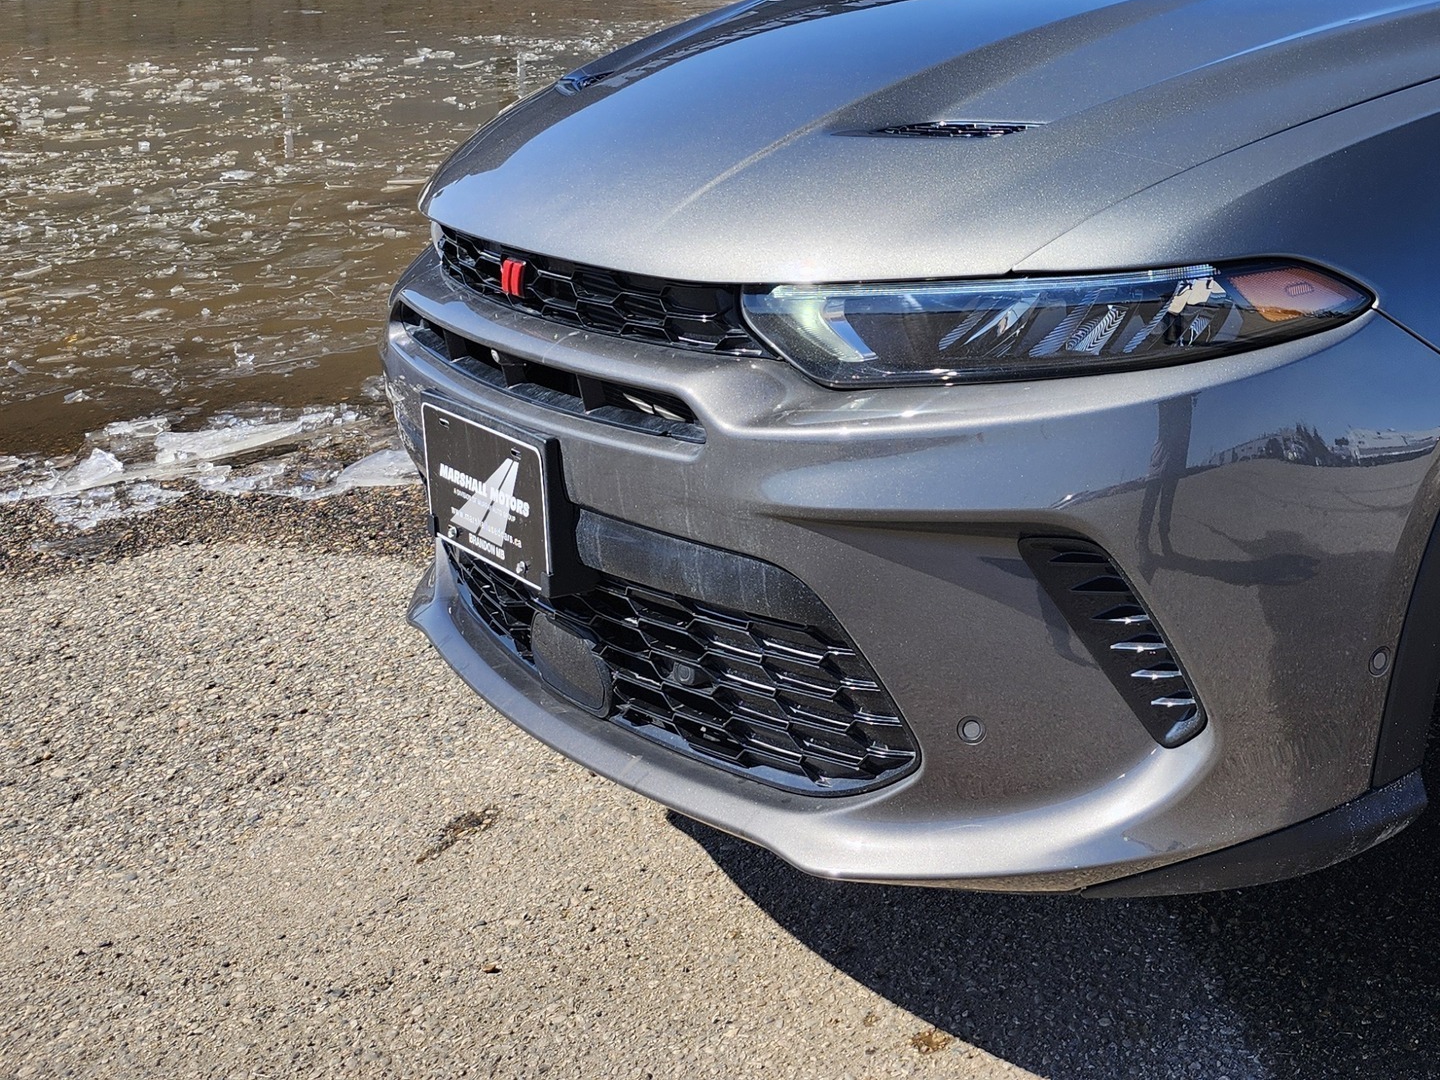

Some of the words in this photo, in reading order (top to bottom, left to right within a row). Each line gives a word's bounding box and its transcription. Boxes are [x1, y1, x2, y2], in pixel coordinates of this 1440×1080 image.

[439, 462, 488, 498] MARSHALL
[490, 487, 531, 518] MOTORS
[468, 532, 496, 556] BRANDON
